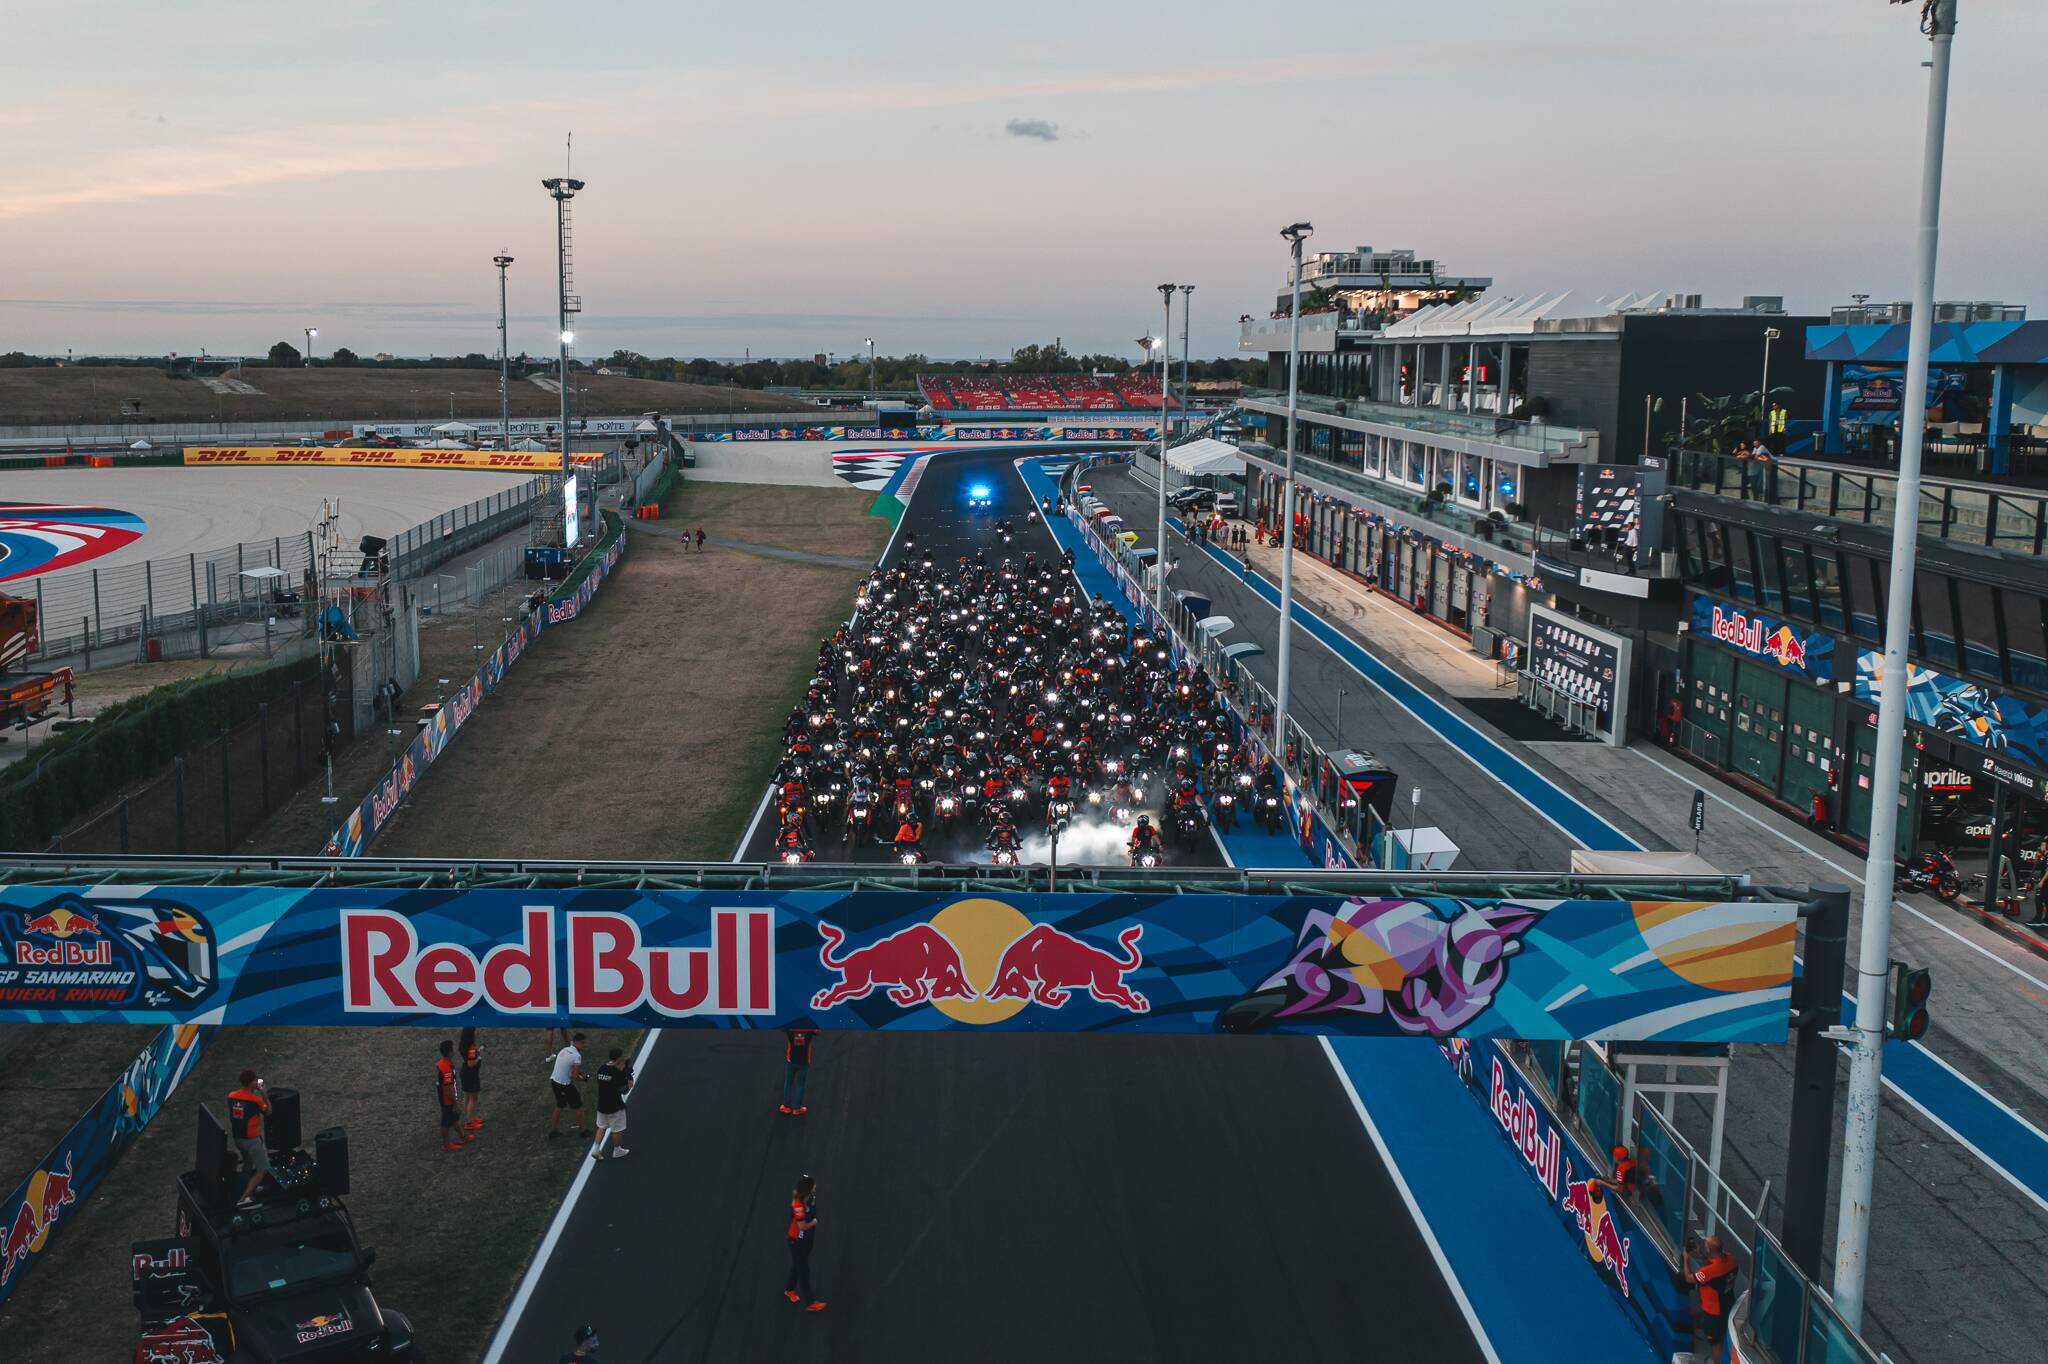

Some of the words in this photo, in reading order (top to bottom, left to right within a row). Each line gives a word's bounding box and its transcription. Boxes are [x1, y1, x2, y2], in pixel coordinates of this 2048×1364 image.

[197, 450, 251, 462] DHL
[275, 450, 325, 462] DHL
[350, 451, 396, 463] DHL
[419, 452, 467, 464] DHL
[488, 454, 535, 466] DHL
[1712, 606, 1738, 644] Red
[1737, 614, 1763, 654] Bull
[1983, 759, 1994, 770] 12
[1965, 824, 1992, 836] aprili
[16, 941, 63, 965] Red
[65, 940, 112, 965] Bull
[340, 905, 557, 1015] Red
[566, 906, 777, 1018] Bull
[0, 987, 57, 1001] IVIERA
[65, 988, 128, 1001] RIMINI
[1490, 1055, 1525, 1151] Red
[1523, 1098, 1561, 1201] Bull
[297, 1327, 326, 1344] Red
[325, 1319, 353, 1336] Bull
